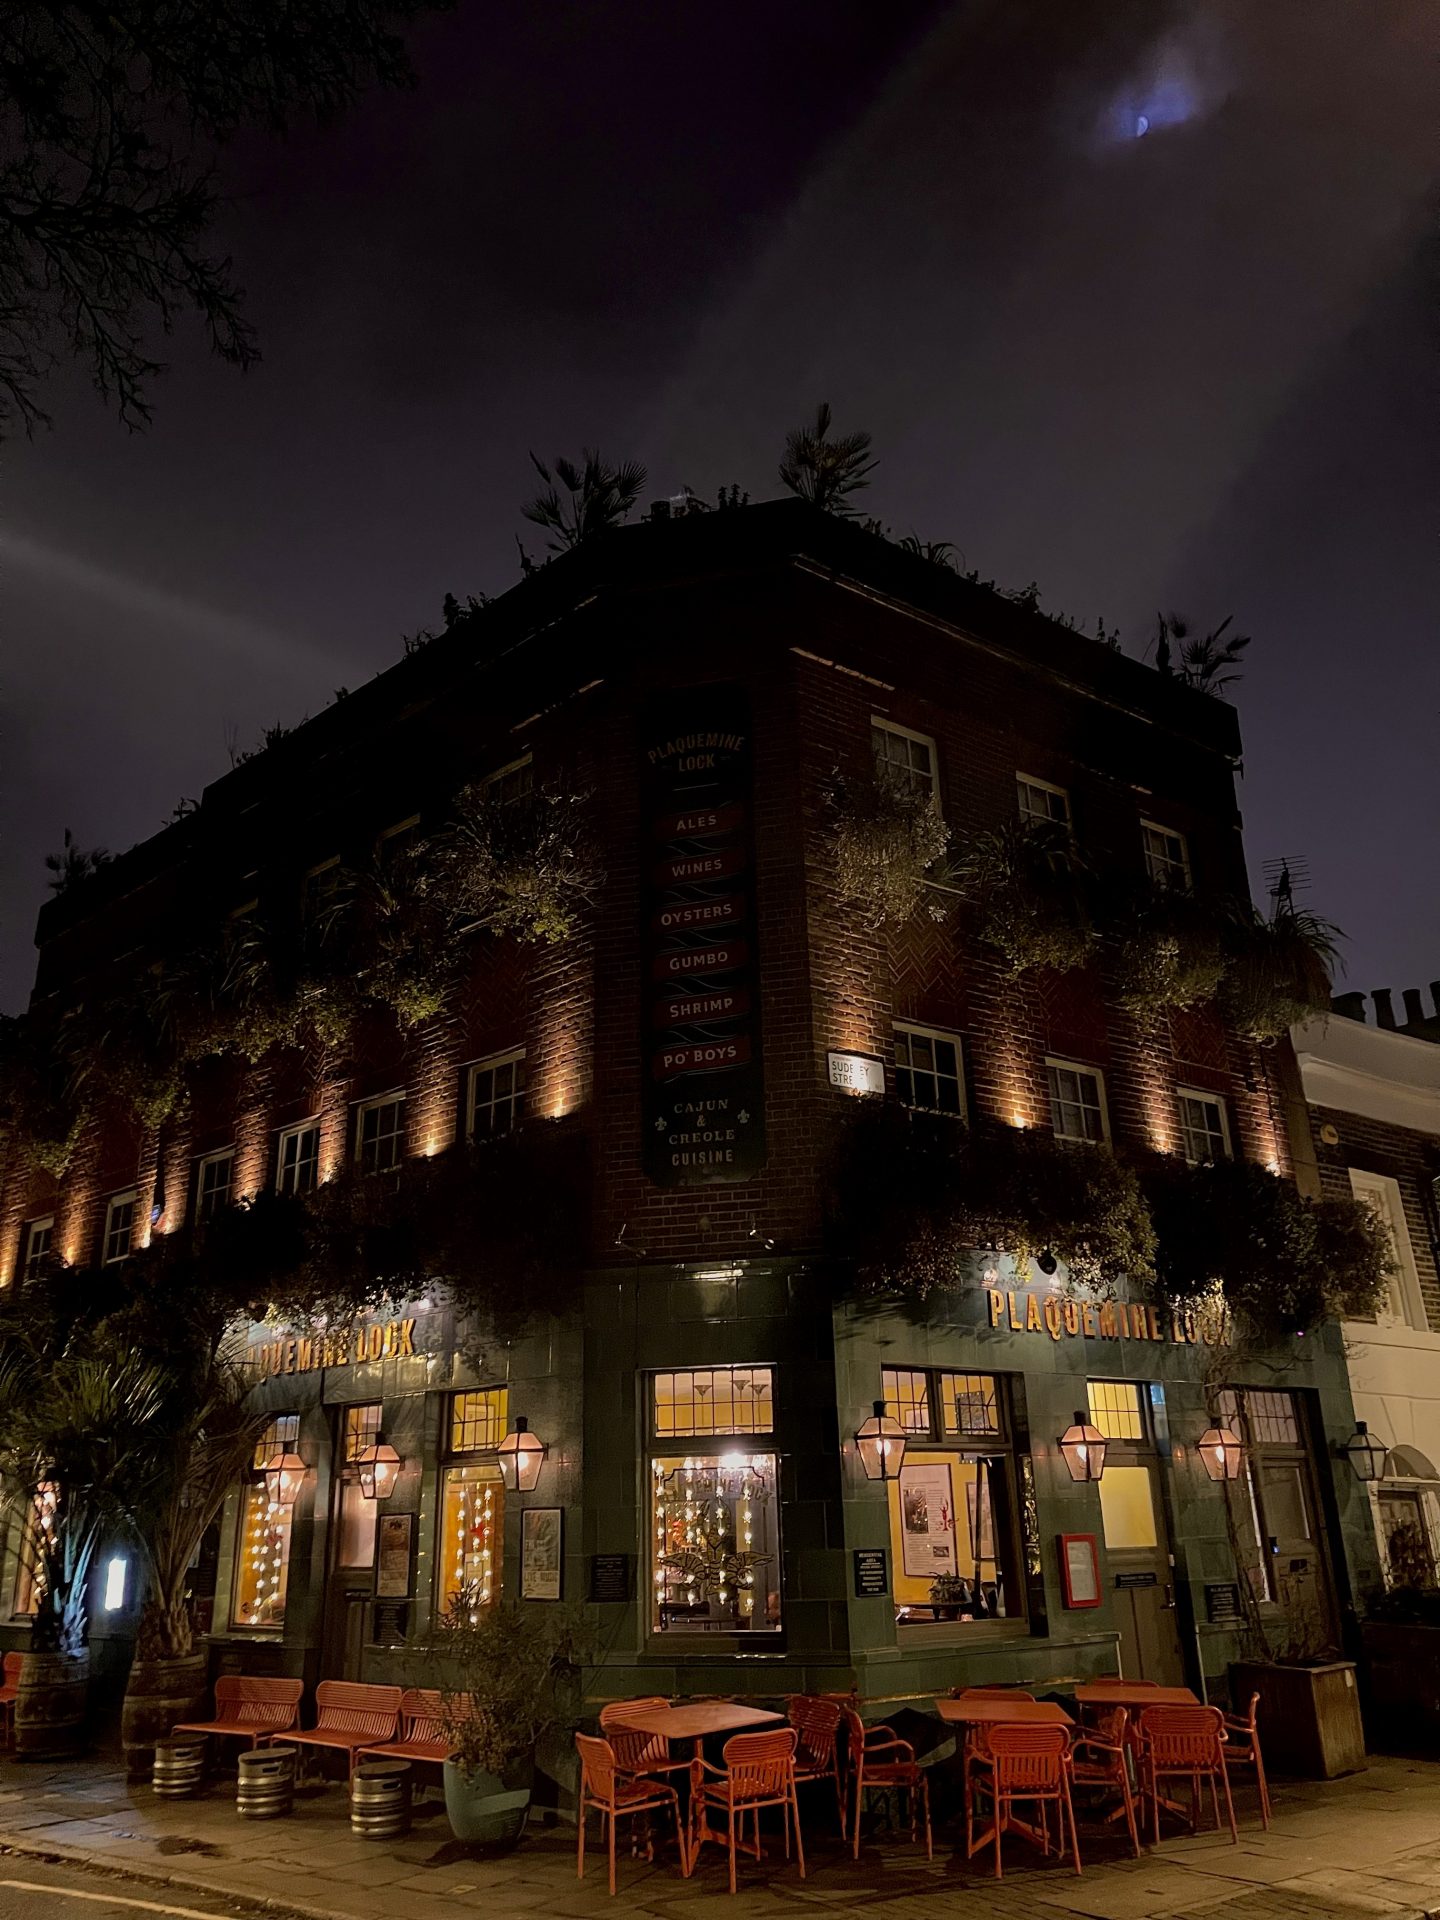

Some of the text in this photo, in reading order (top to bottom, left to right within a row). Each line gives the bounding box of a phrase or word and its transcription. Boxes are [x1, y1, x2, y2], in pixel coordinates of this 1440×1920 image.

[647, 731, 746, 764] PLAQUEMINE
[678, 753, 716, 772] LOCK
[676, 815, 718, 831] ALES
[672, 859, 723, 877] WINES
[660, 904, 733, 926] OYSTERS
[669, 951, 728, 970] GUMBO
[669, 997, 733, 1017] SHRIMP
[694, 1045, 737, 1062] BOYS
[832, 1061, 869, 1076] SUDEEY
[673, 1099, 729, 1114] CAJUN
[696, 1114, 706, 1127] &
[668, 1129, 736, 1145] CREOLE
[671, 1150, 734, 1167] CUISINE
[987, 1289, 1165, 1341] PLAQUEMINE
[356, 1318, 416, 1363] LOCK
